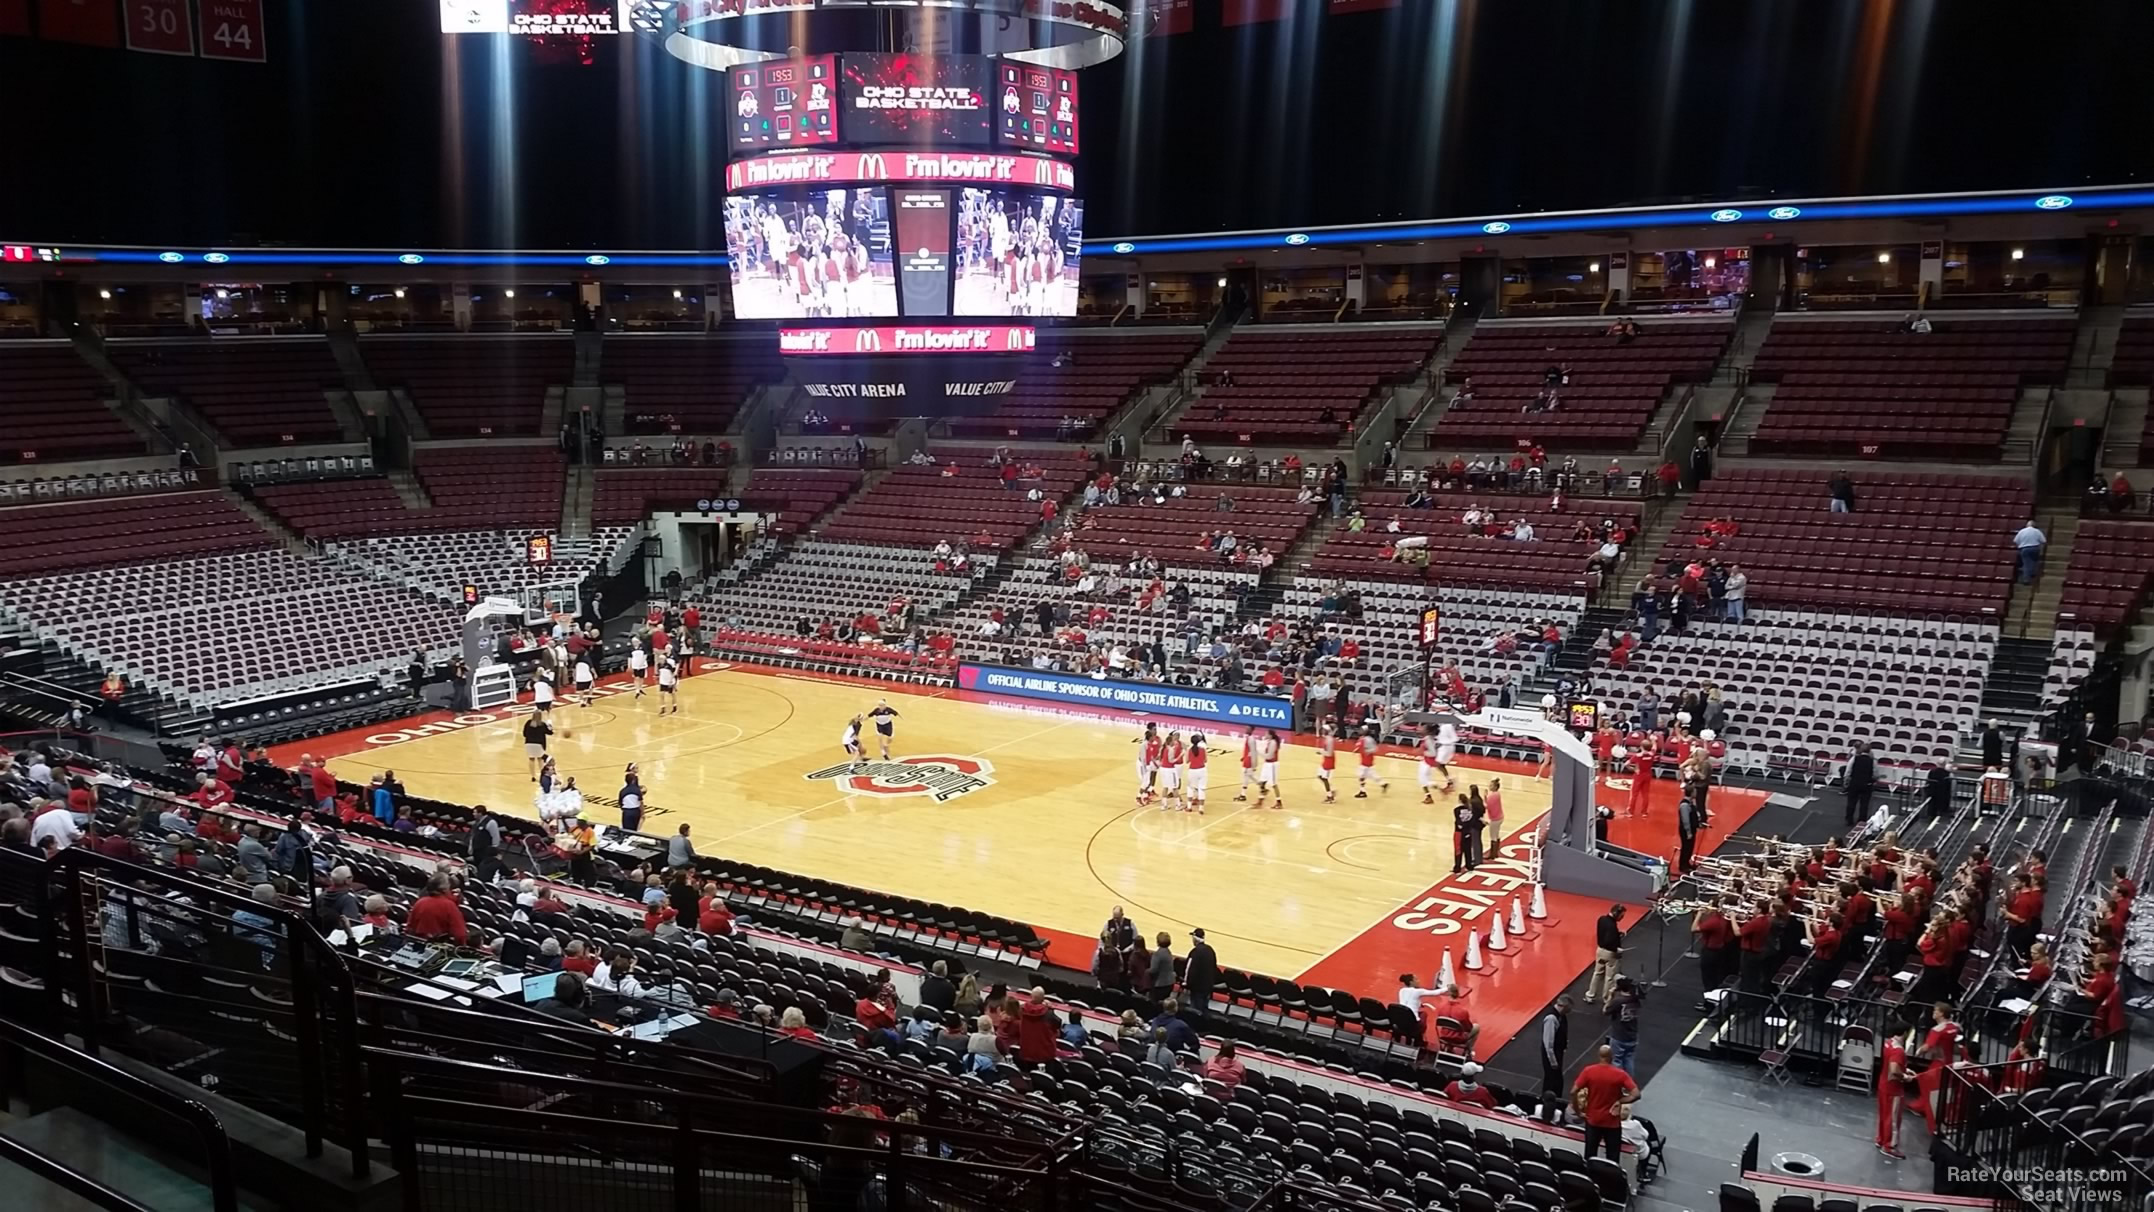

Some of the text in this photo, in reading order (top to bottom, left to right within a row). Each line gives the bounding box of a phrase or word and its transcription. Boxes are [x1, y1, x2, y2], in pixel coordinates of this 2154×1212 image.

[214, 5, 246, 19] HALL
[140, 5, 177, 35] 30
[514, 14, 612, 25] OHIO STATE
[213, 22, 252, 50] 44
[509, 24, 618, 35] BASKETBALL
[863, 86, 971, 99] OHIO STATE
[855, 97, 979, 110] BASKETBALL
[767, 156, 814, 180] lovin'
[906, 154, 939, 177] i'm
[940, 153, 995, 178] lovin'
[895, 330, 925, 349] i'm
[925, 329, 973, 349] lovin'
[831, 384, 858, 397] CITY
[860, 383, 907, 397] ARENA
[945, 383, 983, 396] VALUE
[1862, 446, 1879, 454] 107
[530, 546, 547, 562] 30
[987, 672, 1219, 713] OFFICIAL AIRLINE SPONSOR OF OHIO STATE ATHLETICS.
[365, 681, 648, 745] OHIO SATE
[1242, 705, 1286, 720] DELTA
[1575, 714, 1590, 726] 30
